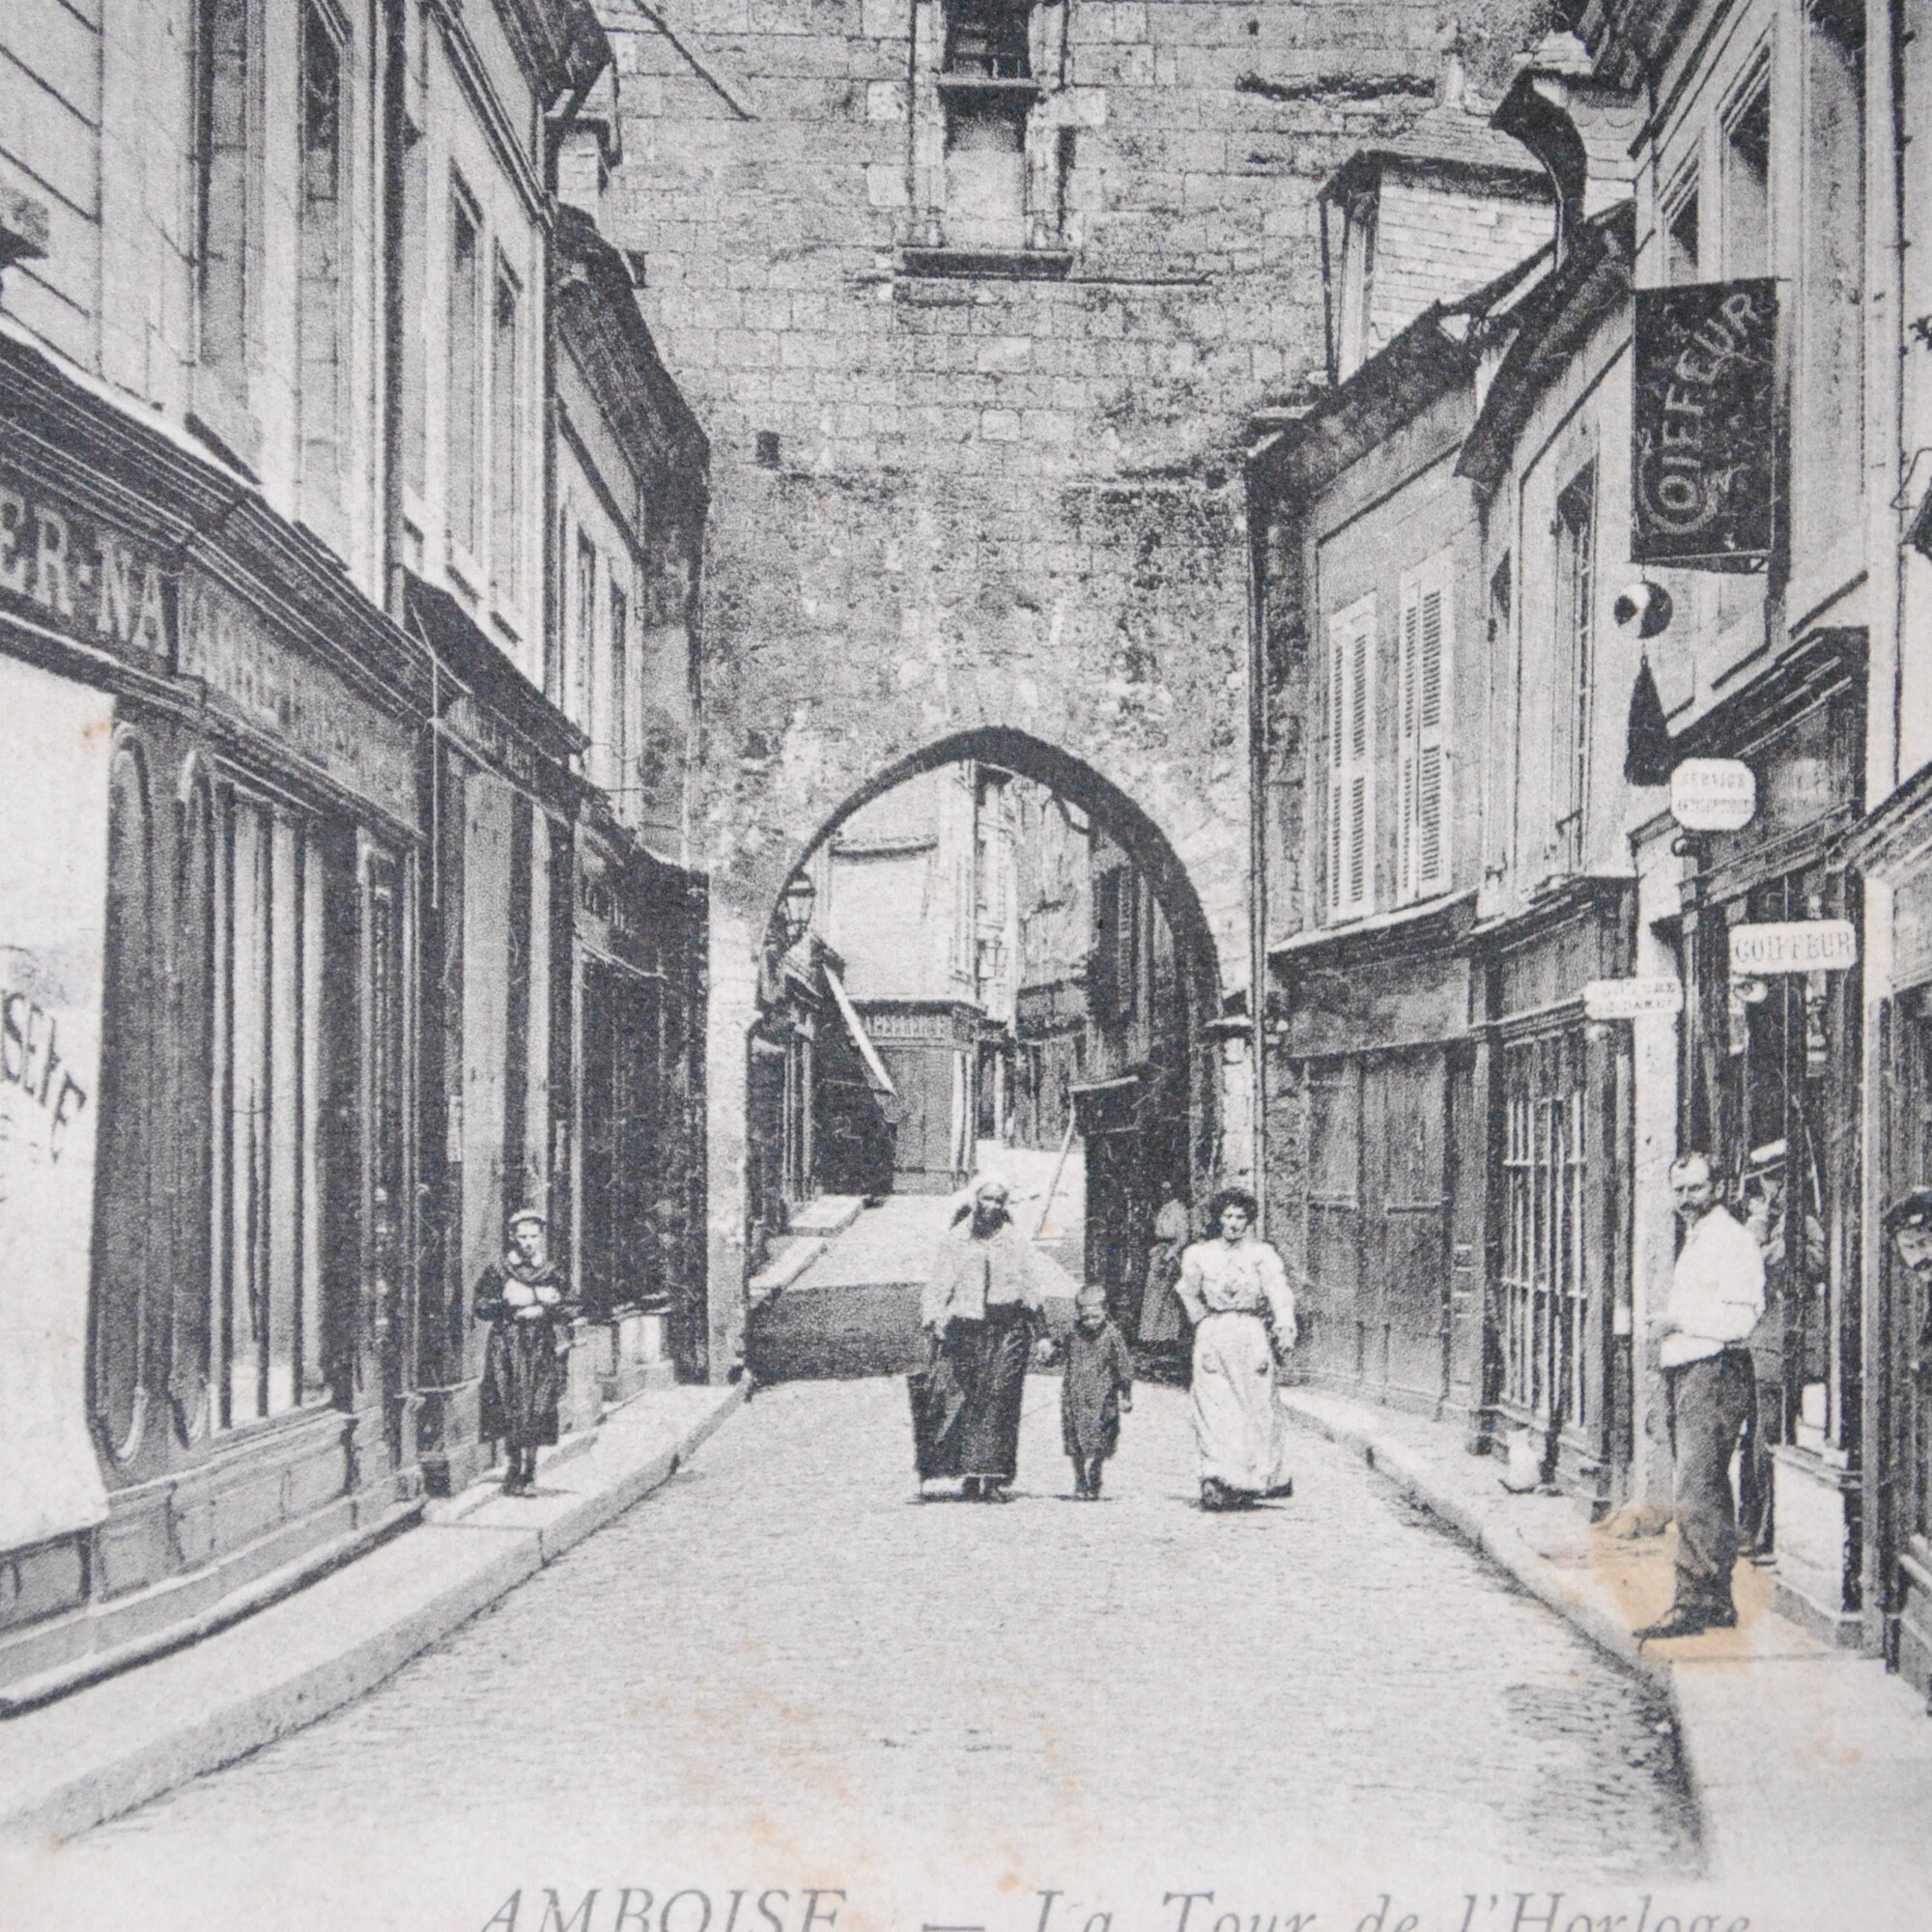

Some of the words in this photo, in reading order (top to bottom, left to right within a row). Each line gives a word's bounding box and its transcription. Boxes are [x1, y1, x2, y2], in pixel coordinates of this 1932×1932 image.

[1735, 931, 1853, 963] COIFFEUR
[482, 1887, 847, 1932] AMBOISE
[1037, 1889, 1114, 1932] La
[1162, 1890, 1316, 1932] Tour
[1354, 1893, 1420, 1932] de
